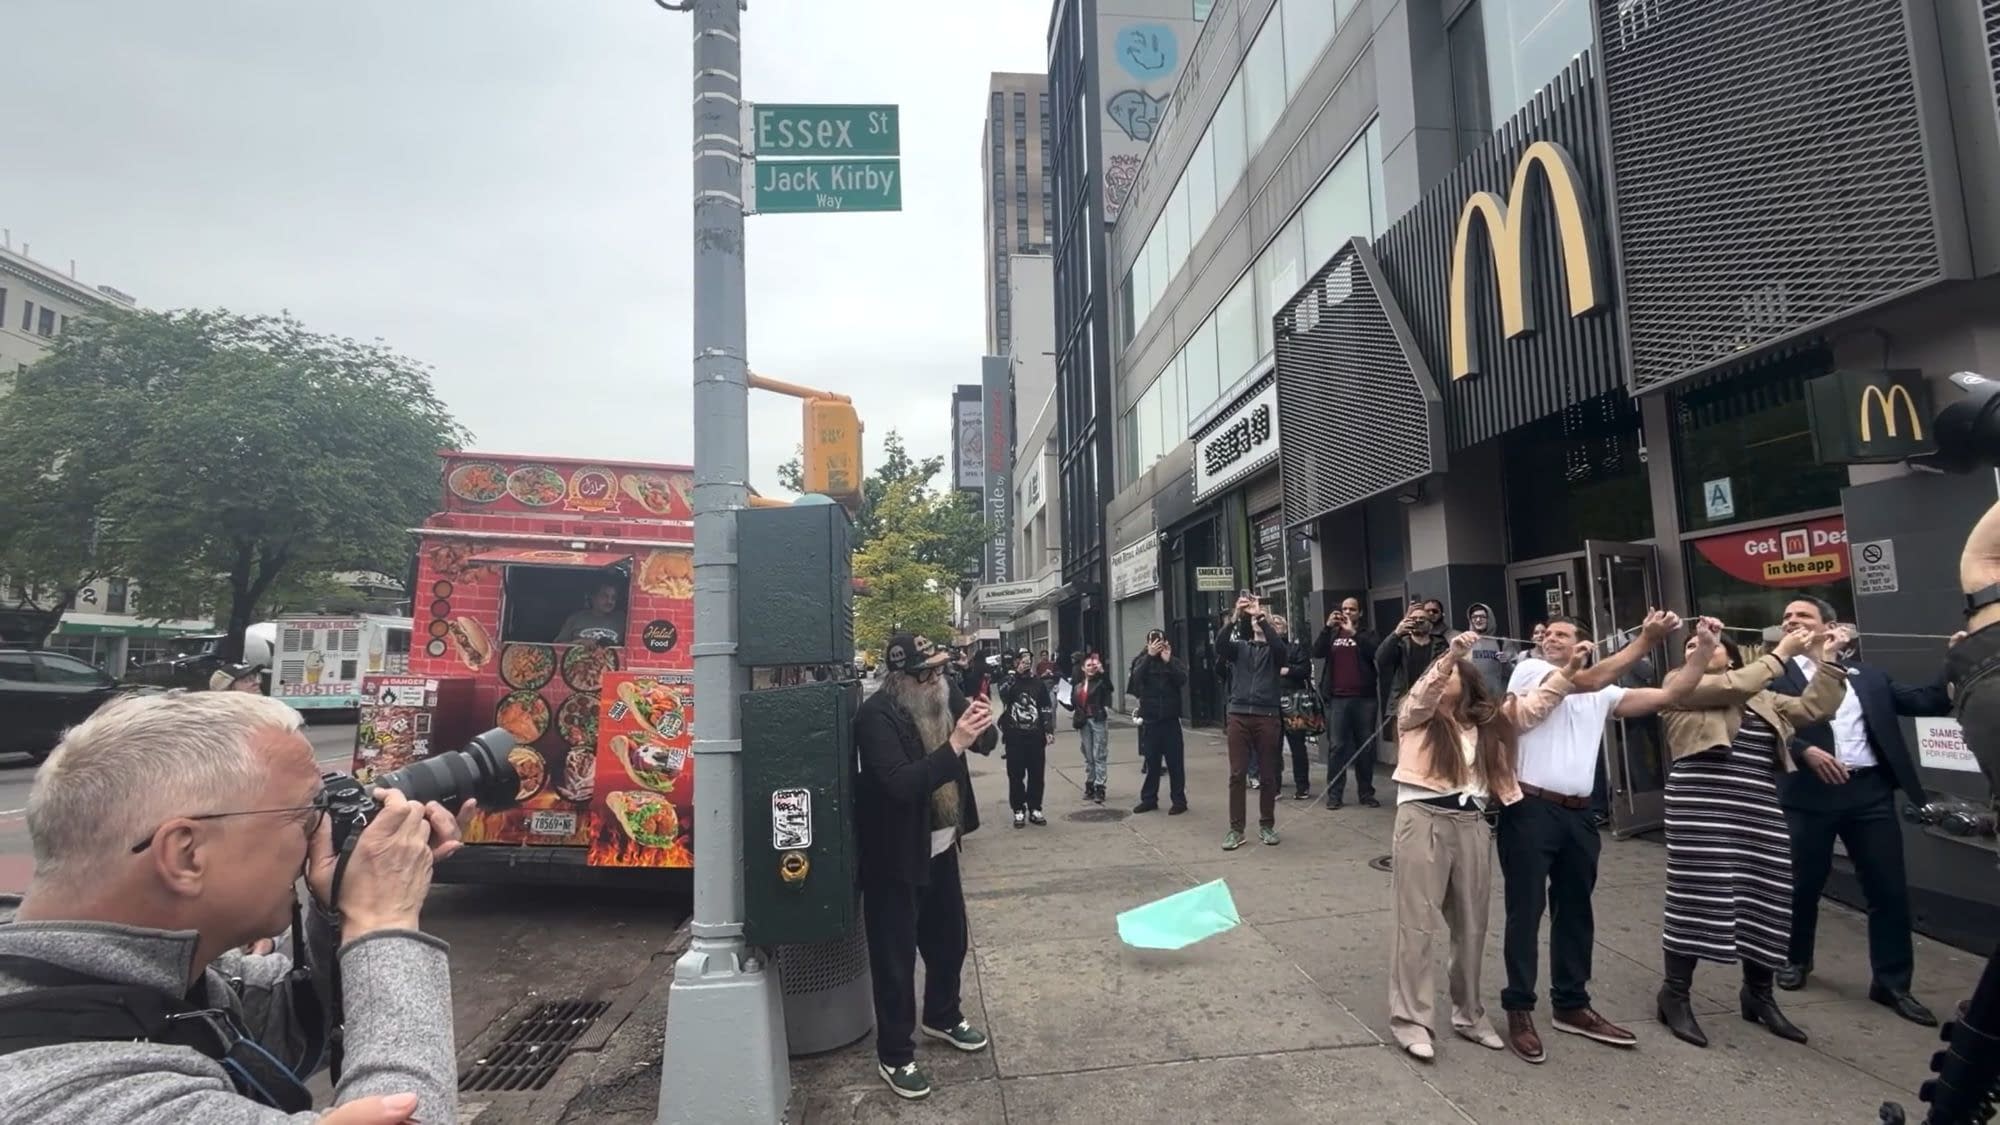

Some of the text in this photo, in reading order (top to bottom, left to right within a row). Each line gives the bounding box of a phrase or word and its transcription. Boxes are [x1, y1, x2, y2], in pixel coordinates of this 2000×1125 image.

[759, 111, 888, 148] Essex St
[763, 164, 894, 196] Jack Kirby
[816, 193, 843, 209] Way
[1711, 484, 1728, 507] A
[1744, 538, 1778, 556] Get
[1199, 568, 1218, 576] SMOKE
[1767, 559, 1834, 575] in the app
[644, 625, 675, 639] Halal
[650, 638, 669, 648] Food
[282, 683, 352, 696] FROSTEE
